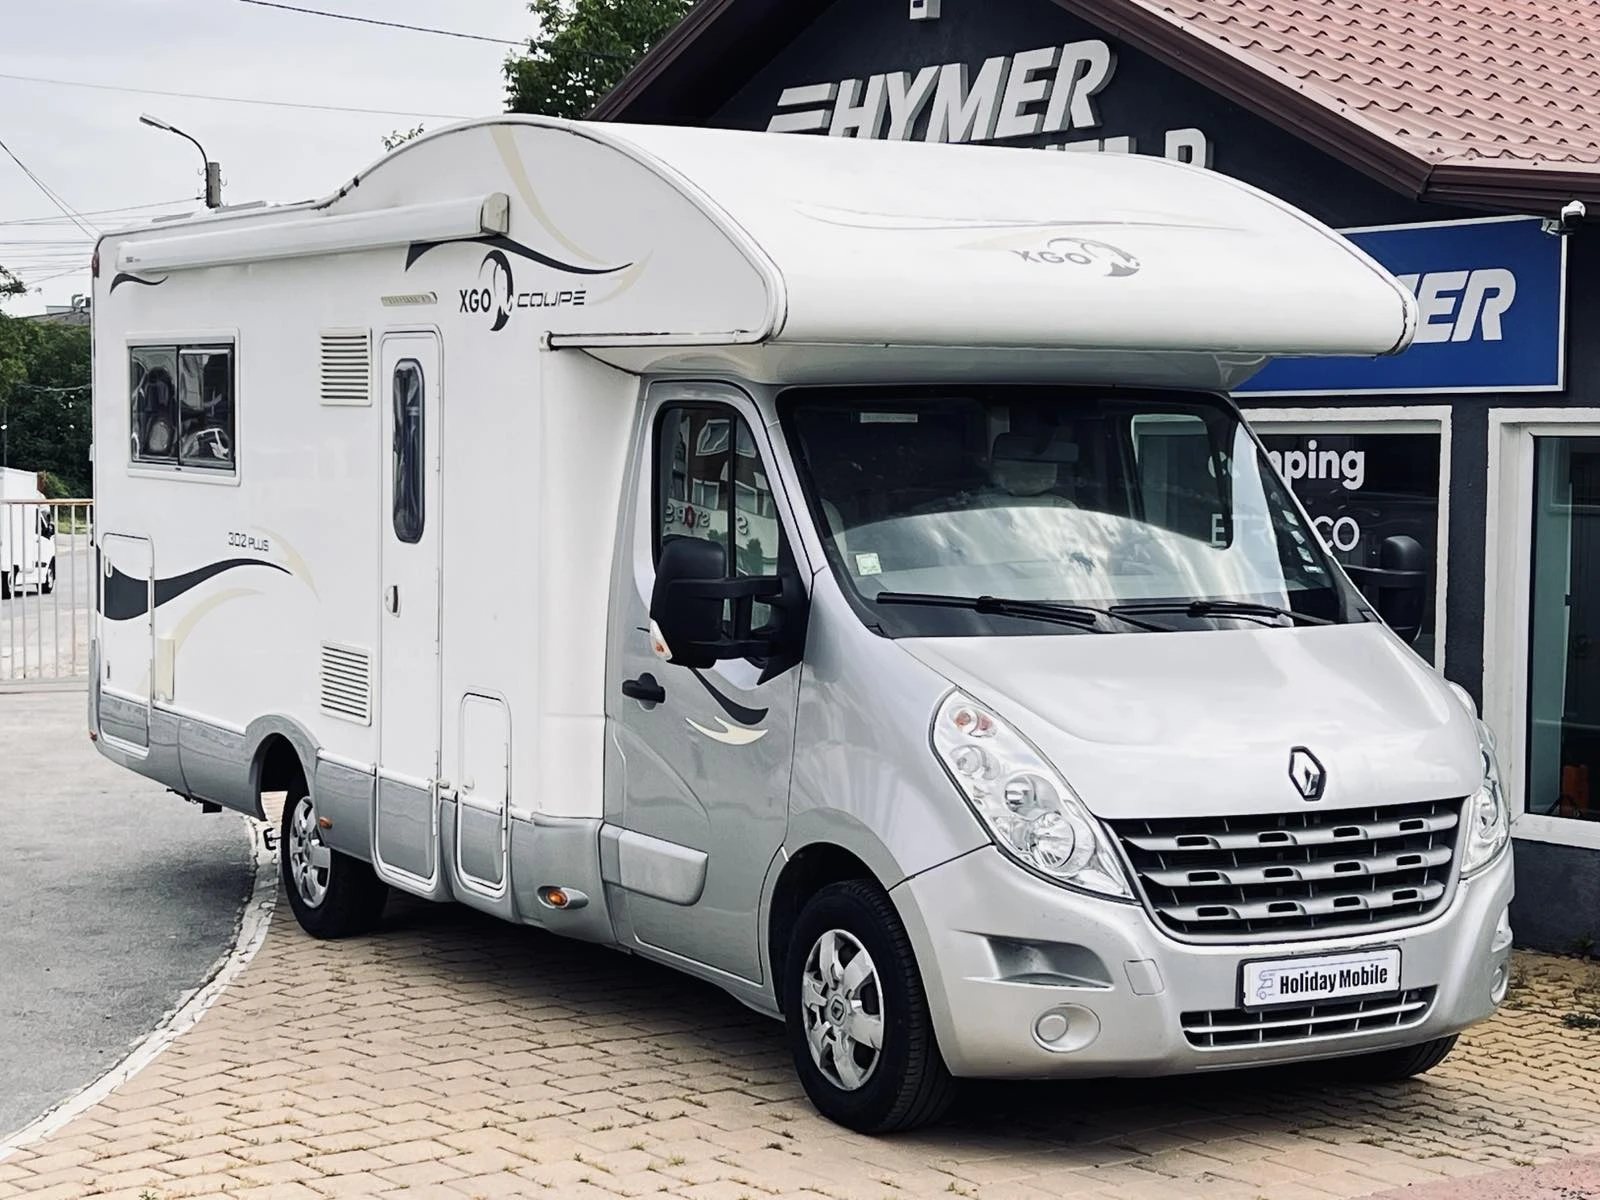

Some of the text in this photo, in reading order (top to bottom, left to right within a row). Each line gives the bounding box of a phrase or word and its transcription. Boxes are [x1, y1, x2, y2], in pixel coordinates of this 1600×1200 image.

[829, 39, 1118, 143] HYMER
[1009, 250, 1092, 265] XGO
[459, 288, 492, 313] XGO
[1397, 268, 1517, 344] ER
[228, 531, 269, 552] 302 PLUS
[1280, 963, 1388, 994] Holiday Mobile
